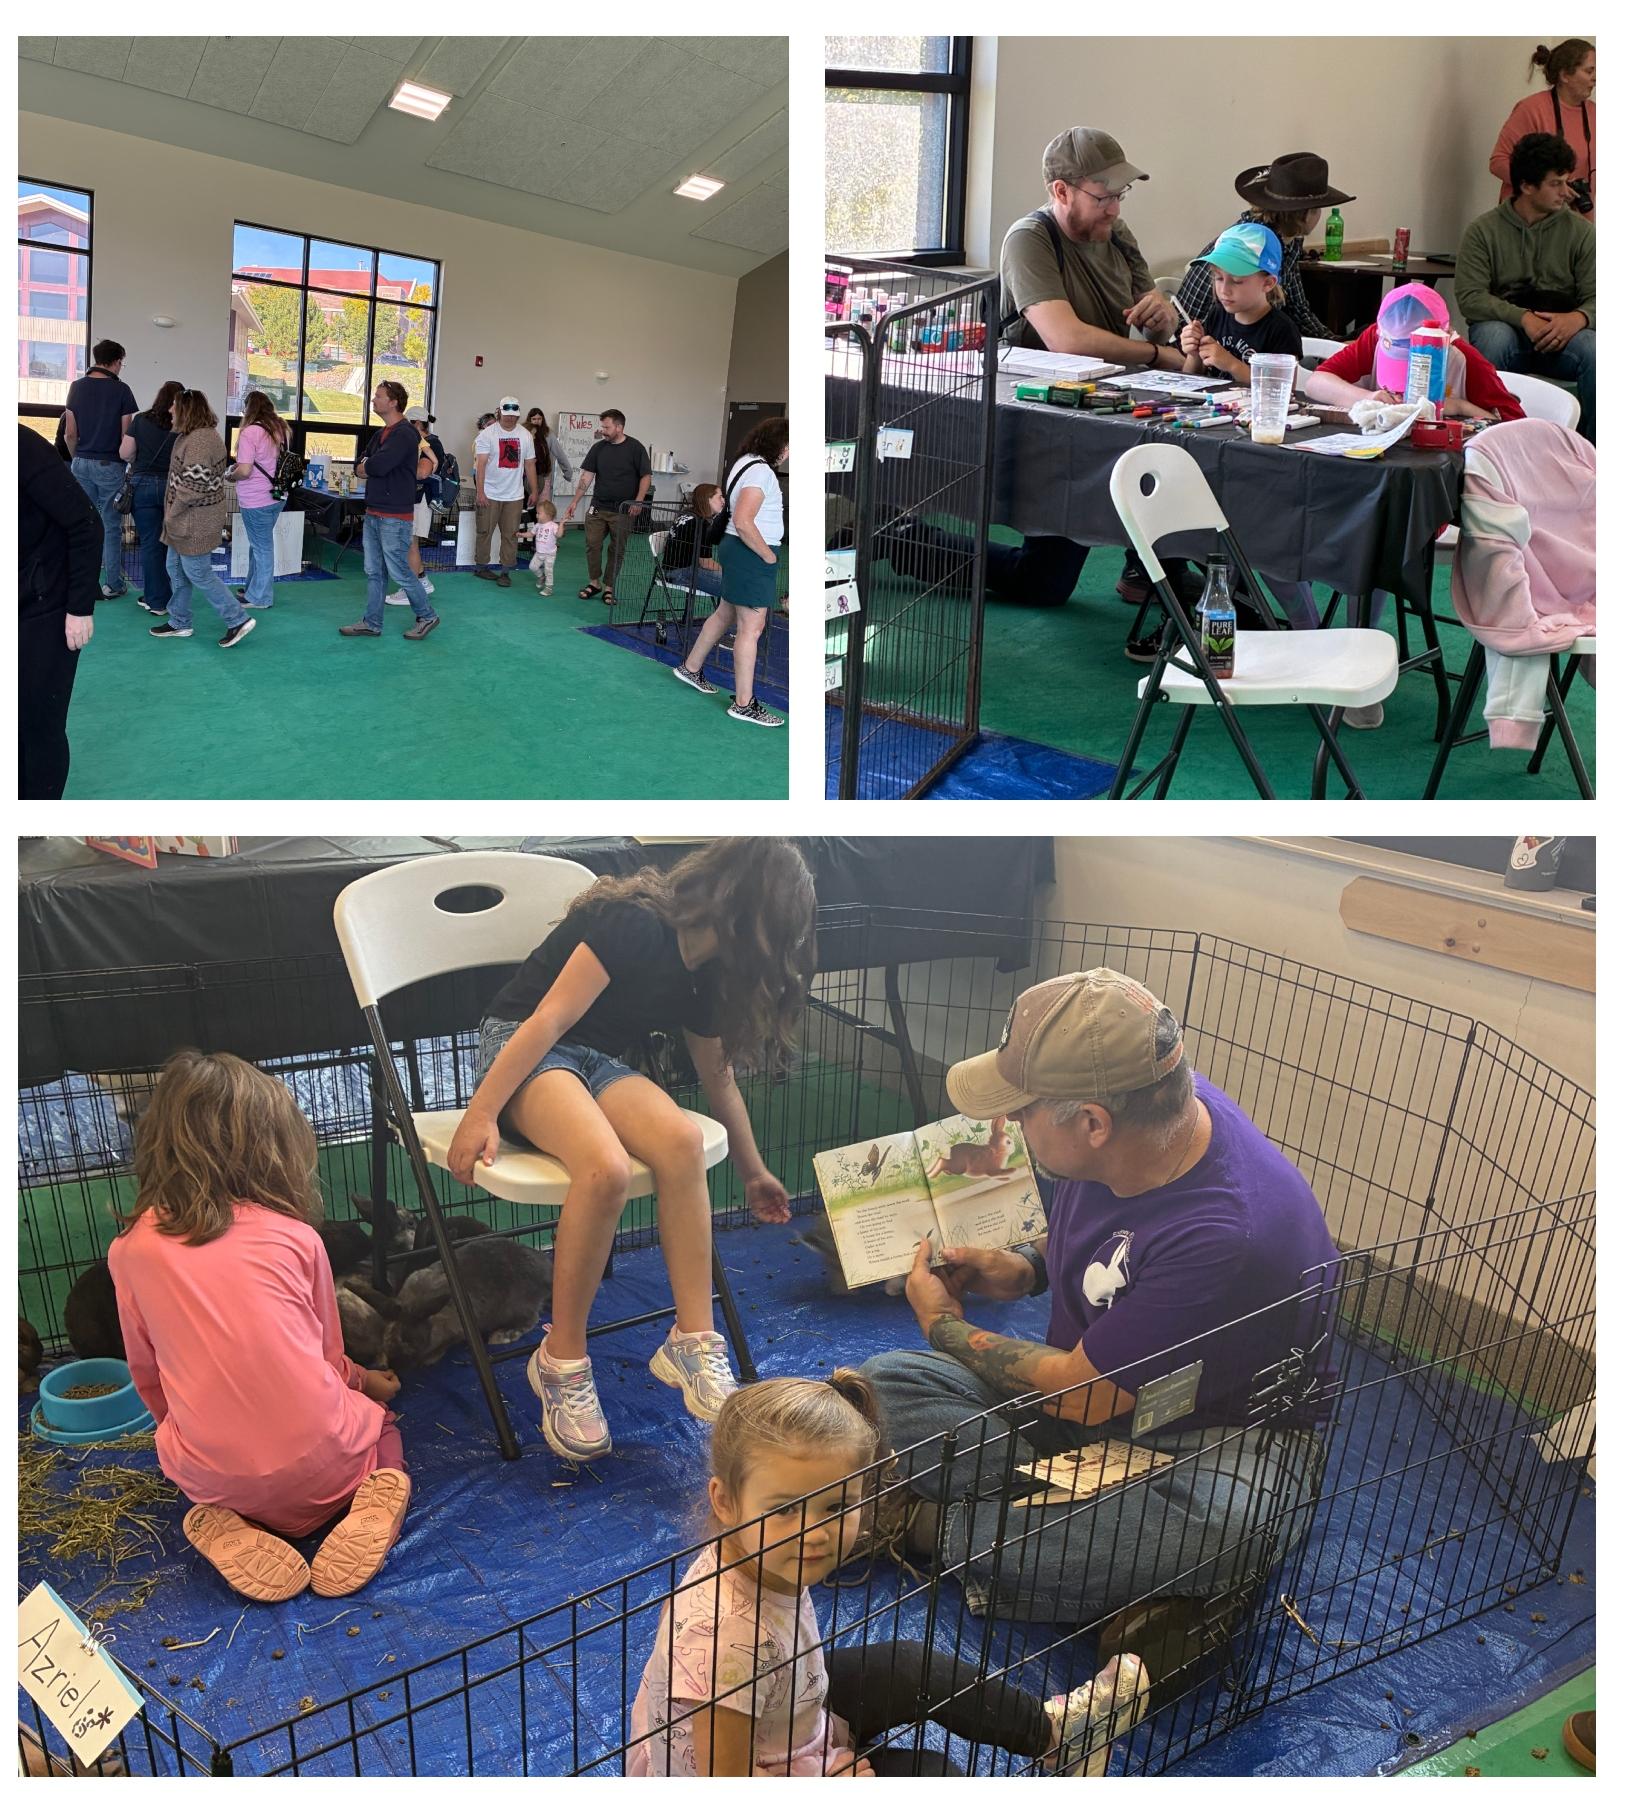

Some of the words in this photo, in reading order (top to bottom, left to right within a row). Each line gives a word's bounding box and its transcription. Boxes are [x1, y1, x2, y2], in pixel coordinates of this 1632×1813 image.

[569, 413, 593, 431] Rules
[1211, 628, 1233, 636] LEAF
[18, 1618, 101, 1719] Azriel
